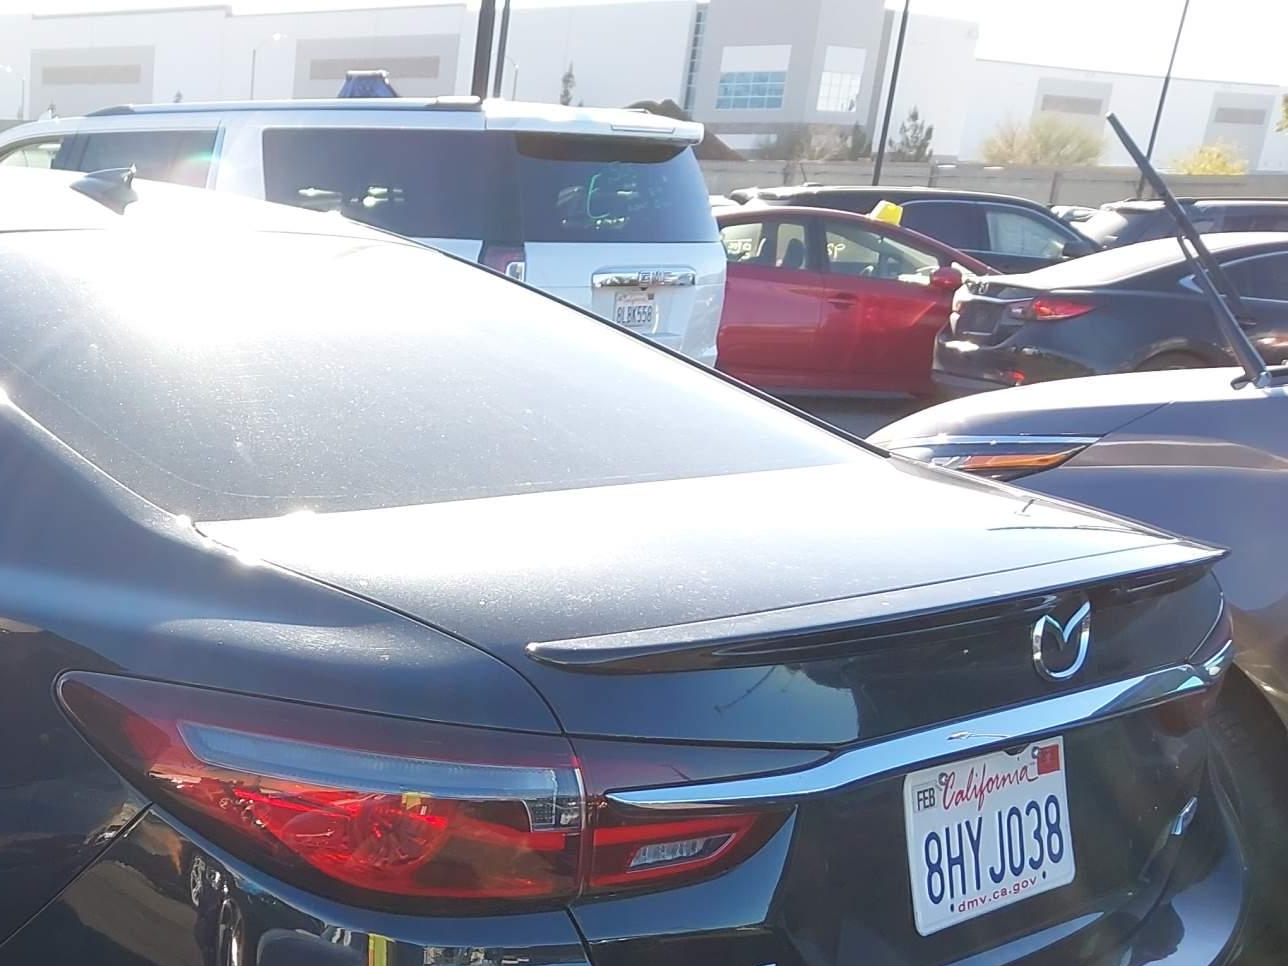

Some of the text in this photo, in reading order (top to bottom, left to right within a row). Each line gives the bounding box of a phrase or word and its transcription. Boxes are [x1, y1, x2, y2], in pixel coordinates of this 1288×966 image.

[917, 763, 1040, 811] FEB California
[924, 794, 1064, 905] 8HYJ038
[958, 876, 1038, 913] dmv.ca.gov
